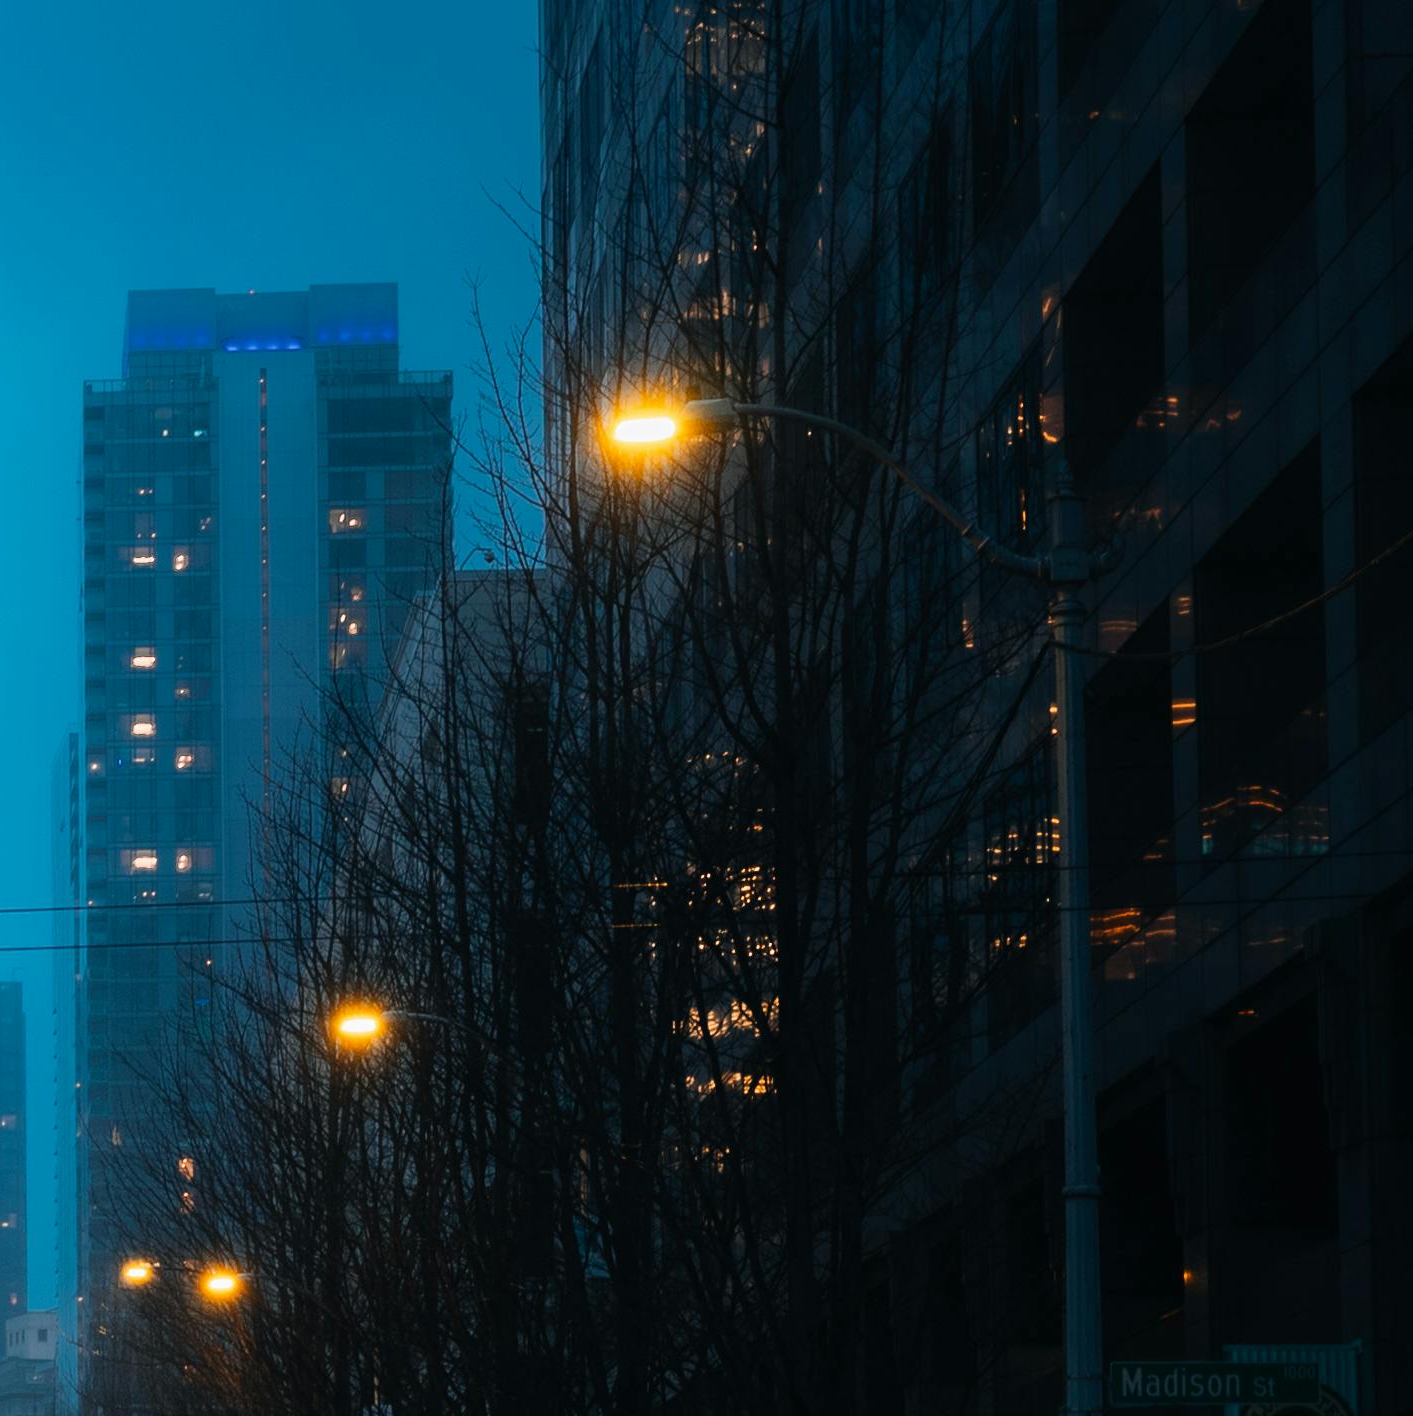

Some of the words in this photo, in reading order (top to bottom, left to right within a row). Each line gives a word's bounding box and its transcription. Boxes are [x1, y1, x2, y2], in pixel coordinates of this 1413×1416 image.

[1122, 1367, 1240, 1397] Madison
[1253, 1377, 1276, 1397] St
[1283, 1366, 1315, 1379] 1000
